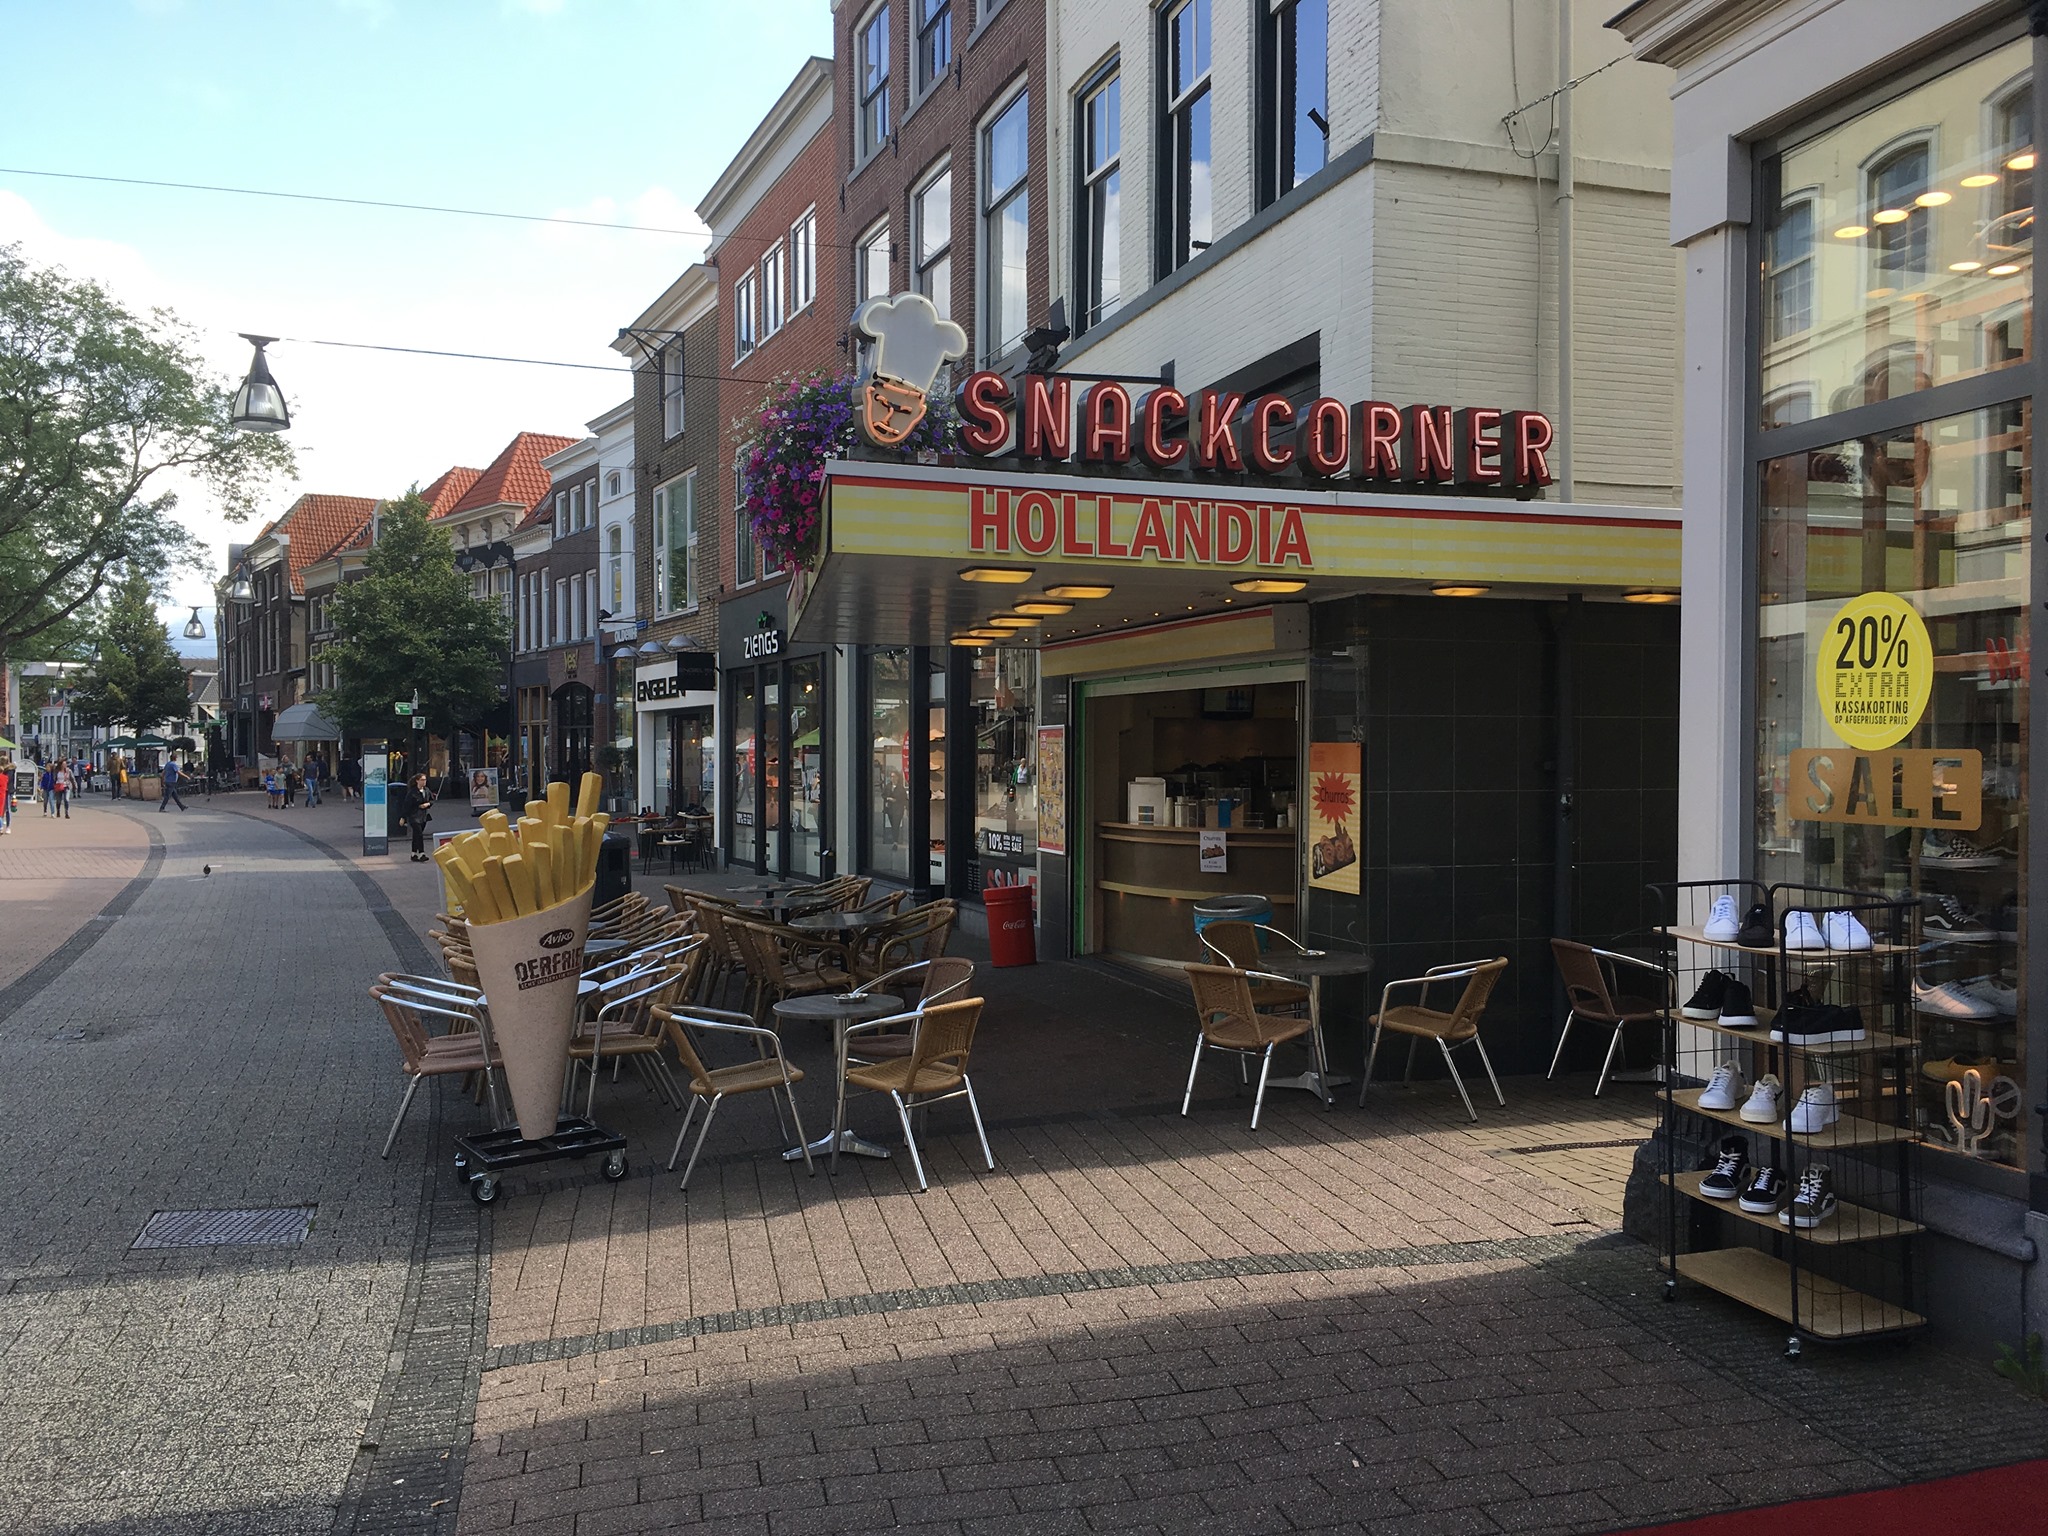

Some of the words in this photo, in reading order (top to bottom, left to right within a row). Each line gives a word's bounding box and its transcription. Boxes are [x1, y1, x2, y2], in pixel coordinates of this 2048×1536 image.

[957, 371, 1554, 487] SNACKCORNER
[967, 486, 1314, 568] HOLLANDIA
[743, 630, 779, 659] ZIENGS
[1836, 613, 1908, 669] 20%
[637, 676, 686, 702] ENGELE
[1835, 671, 1909, 698] EXTRA
[1834, 715, 1843, 724] OP
[1845, 715, 1887, 724] AFGEPRIJSDE
[1889, 715, 1909, 725] PRIJS
[1835, 700, 1909, 714] KASSAKORTING
[1320, 786, 1349, 804] Churros
[1807, 755, 1962, 821] SALE
[988, 832, 1003, 851] 10%
[1011, 842, 1022, 853] SALE
[542, 931, 573, 946] Aviko
